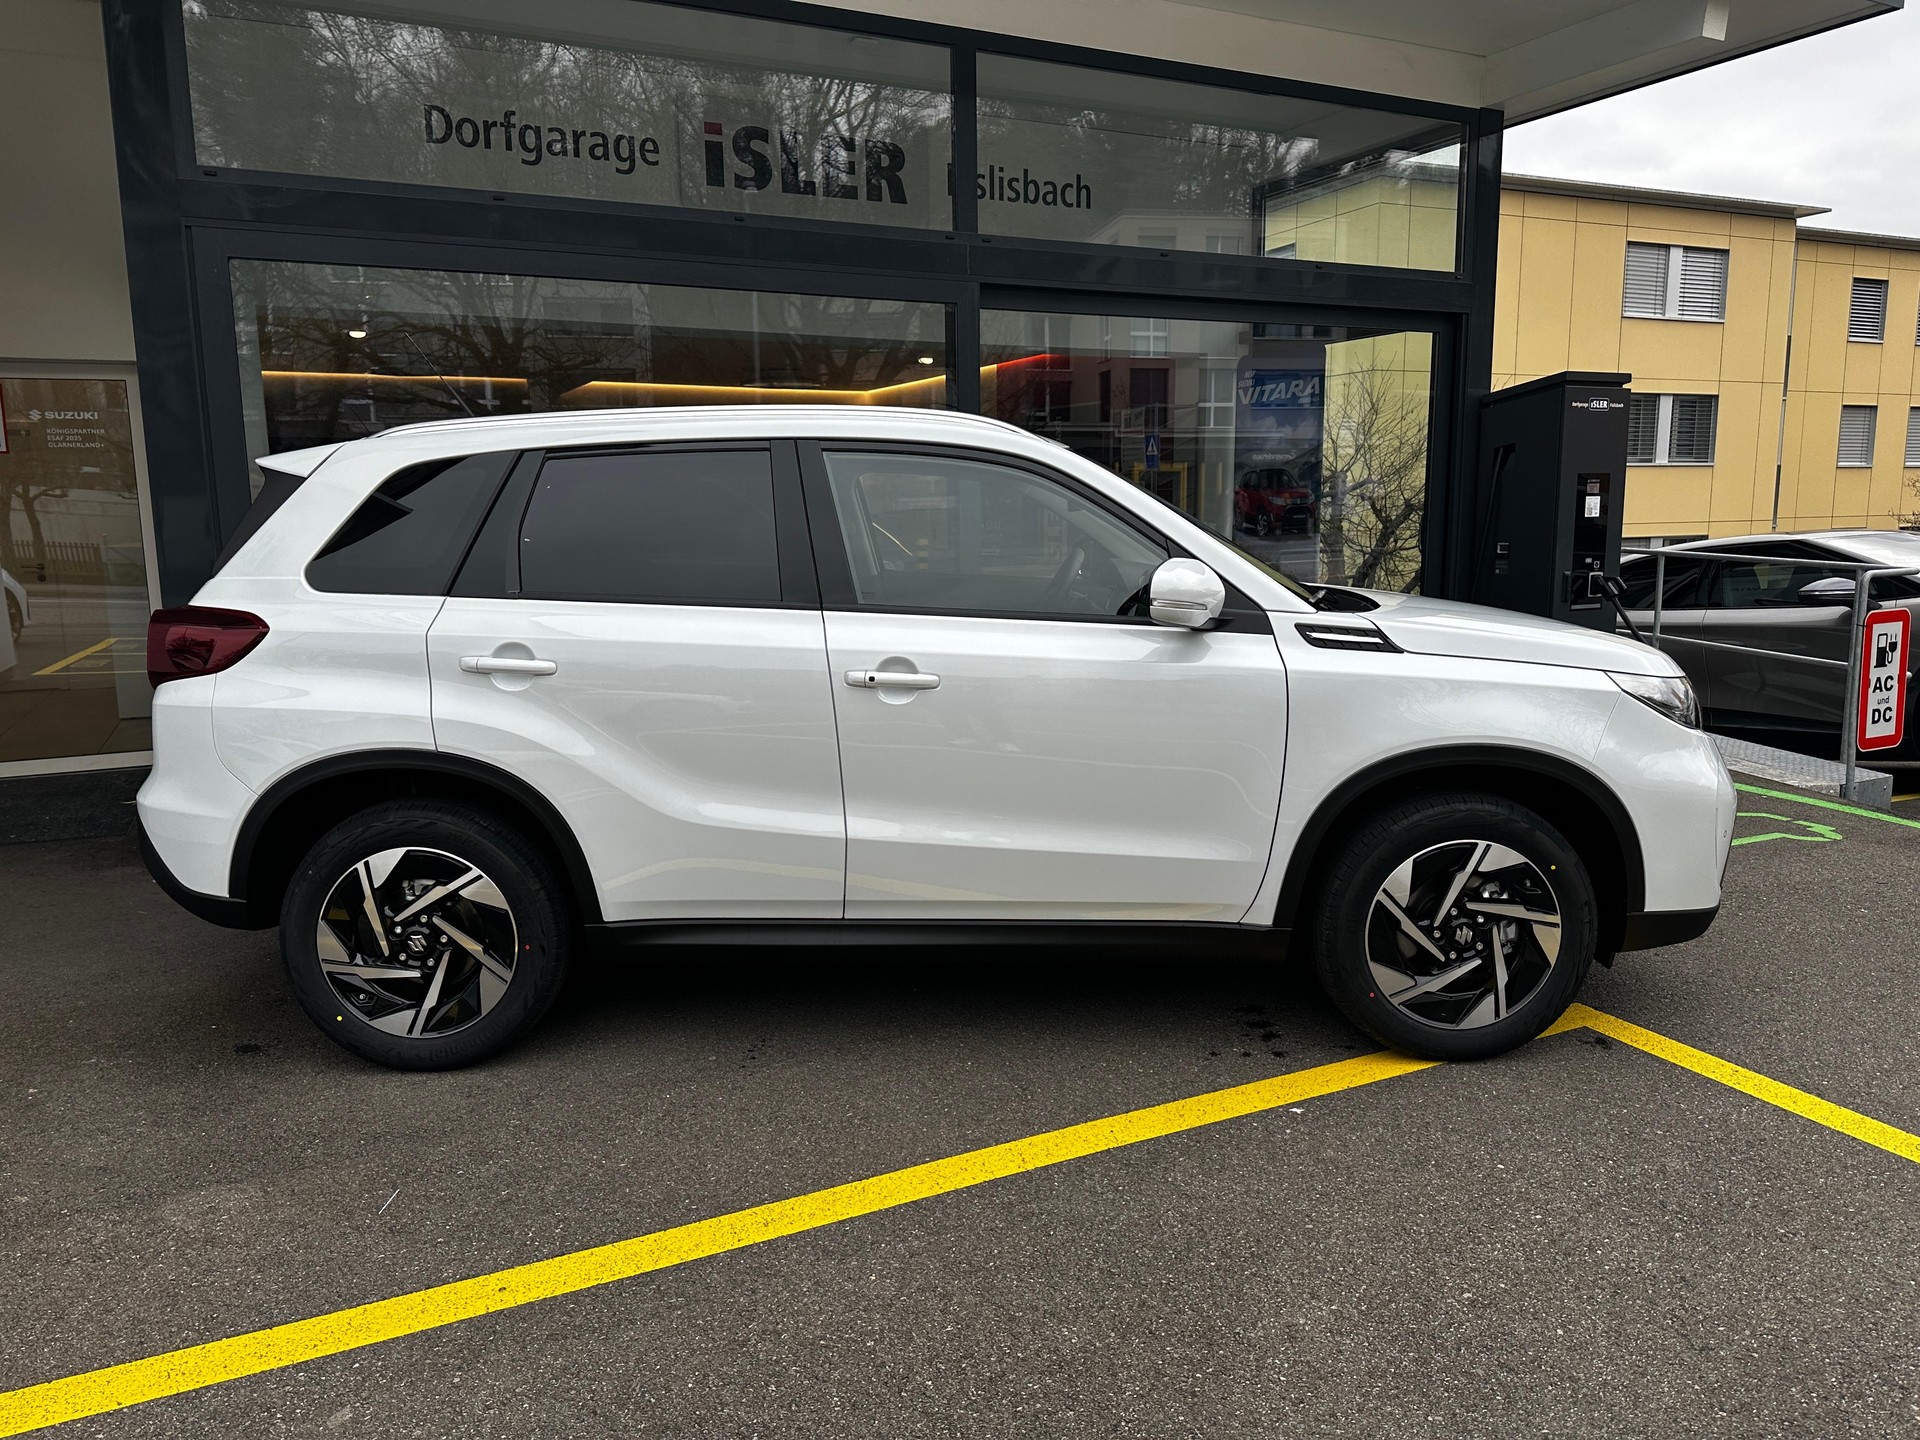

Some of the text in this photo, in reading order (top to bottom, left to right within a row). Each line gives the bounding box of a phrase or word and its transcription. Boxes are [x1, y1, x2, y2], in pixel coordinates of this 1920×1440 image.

[424, 104, 660, 174] Dorfgarage
[947, 162, 1092, 210] slisbach
[1238, 376, 1320, 405] VITARA
[45, 411, 99, 420] SUZUKI
[1872, 675, 1894, 694] AC
[1877, 696, 1890, 705] und
[1871, 707, 1893, 725] DC
